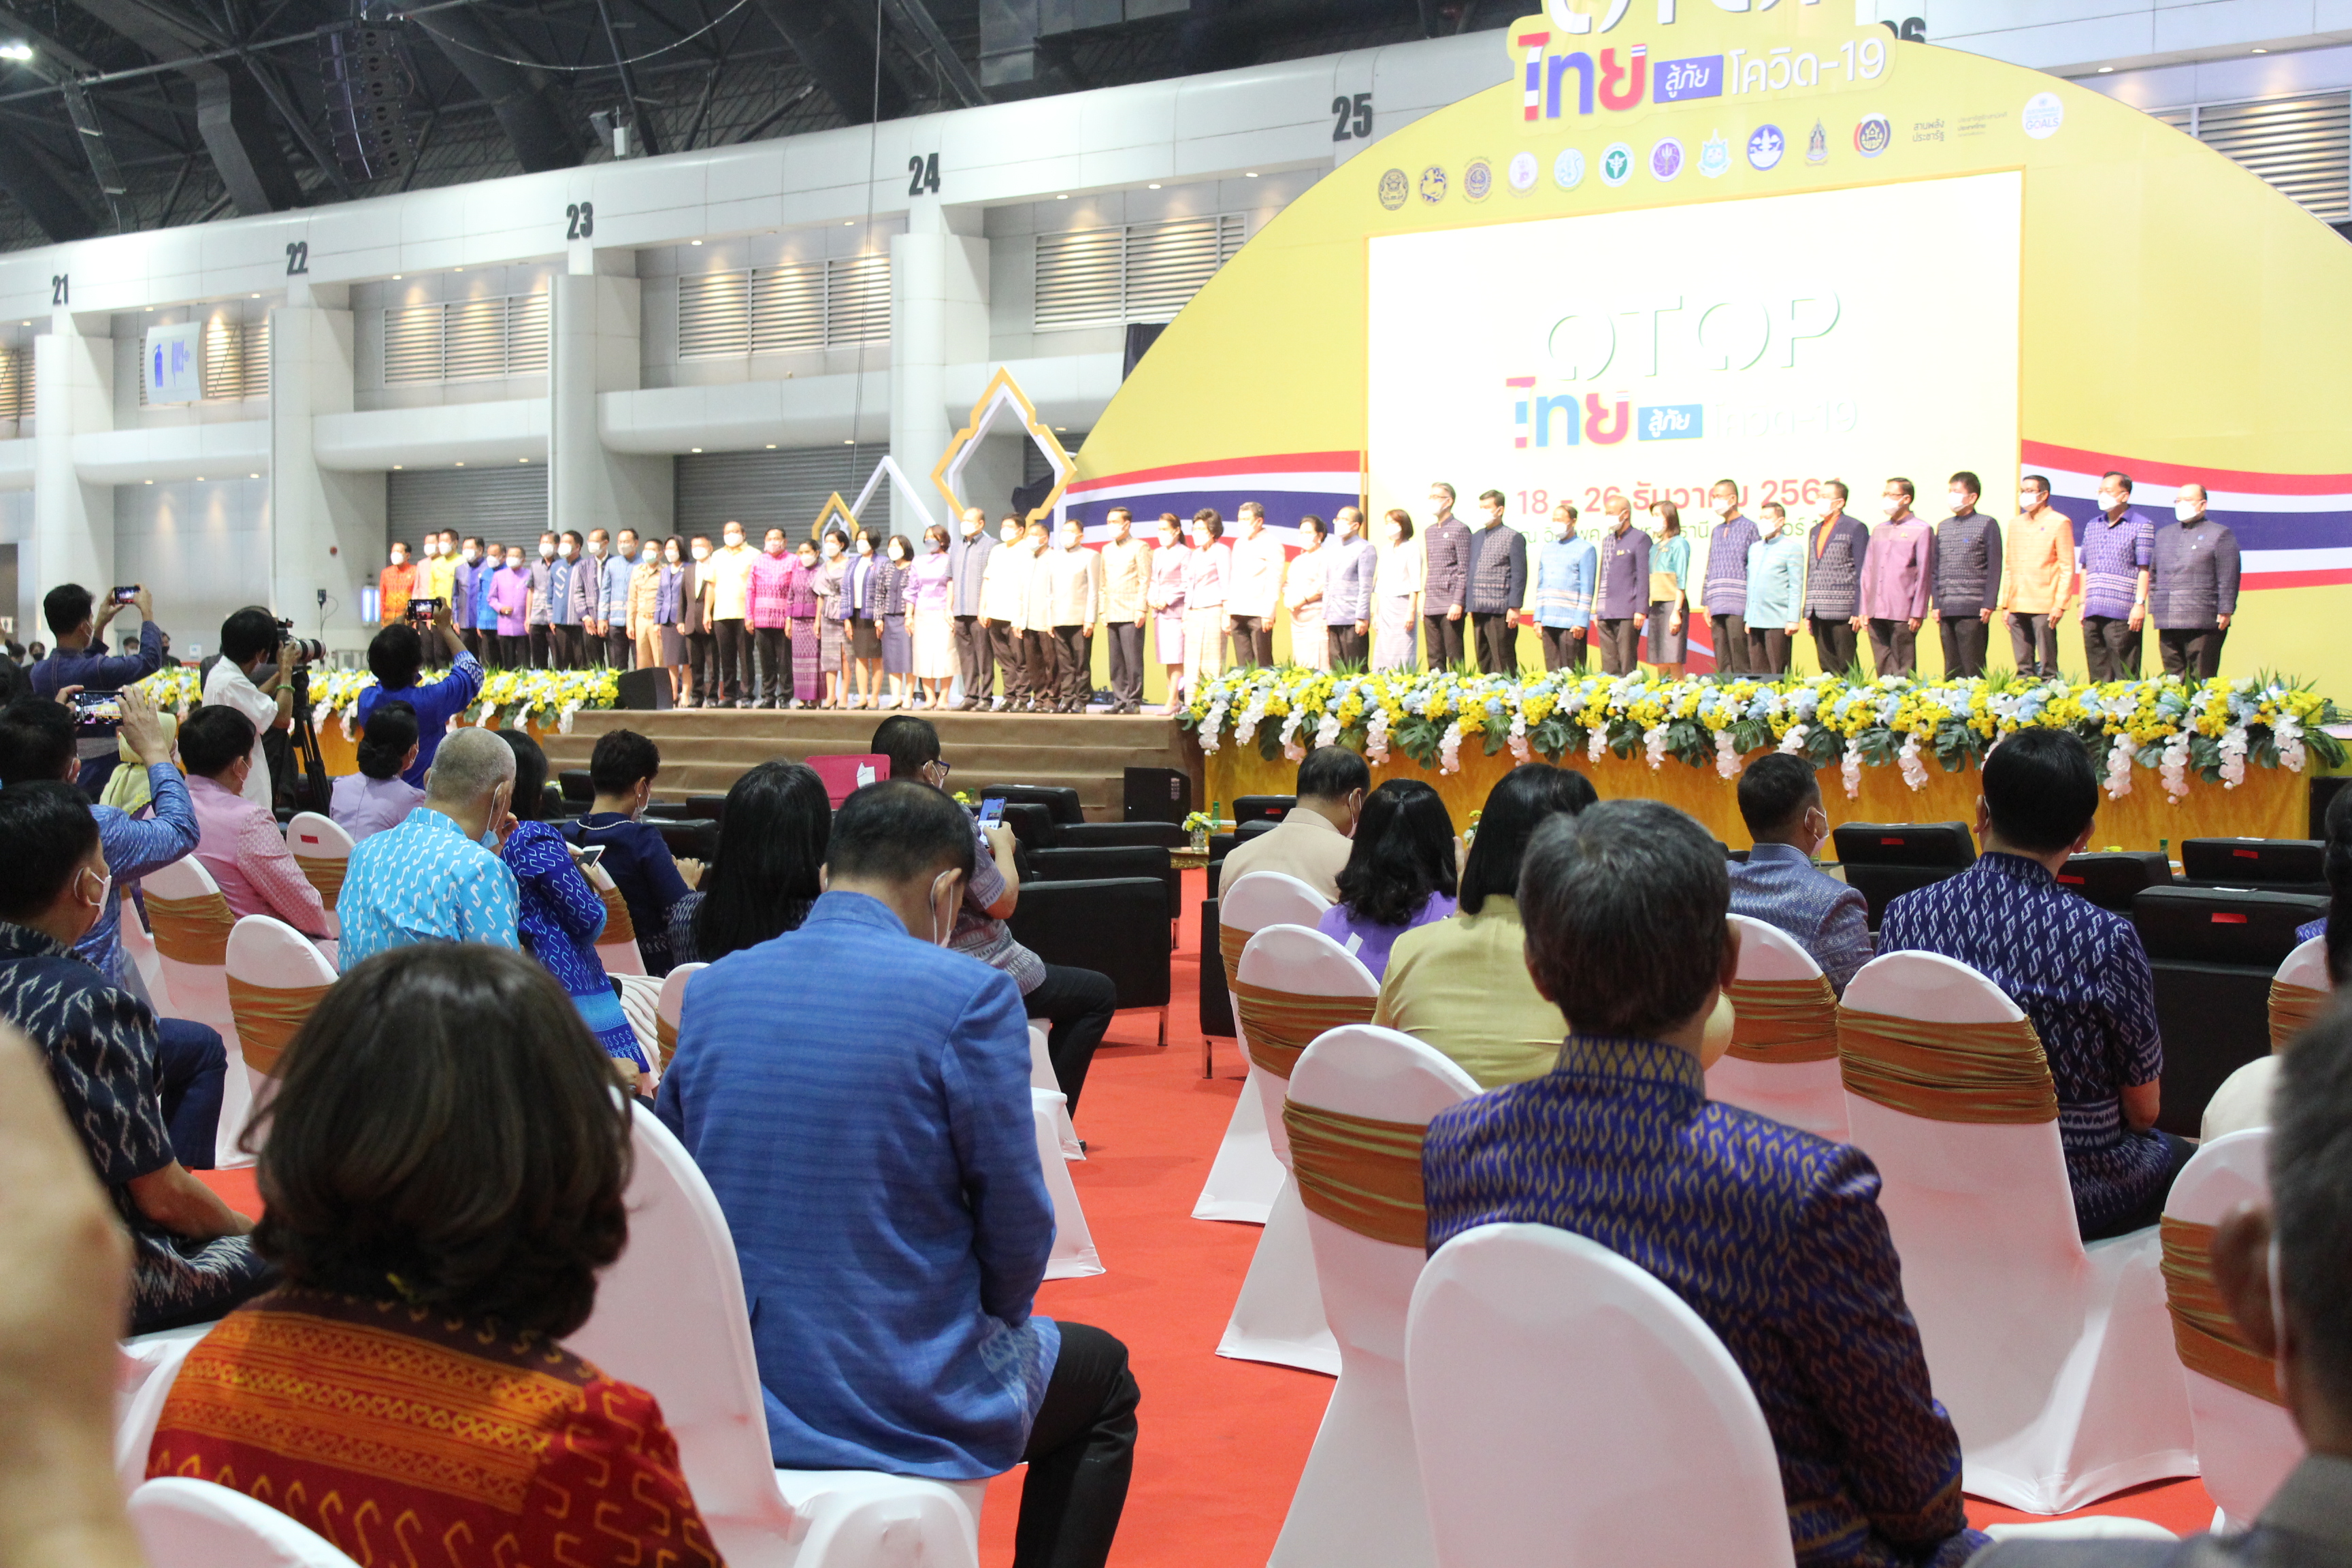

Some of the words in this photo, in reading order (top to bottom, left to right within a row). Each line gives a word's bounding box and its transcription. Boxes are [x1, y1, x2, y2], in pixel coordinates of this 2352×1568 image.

[1518, 31, 1647, 120] ไทย
[1665, 63, 1710, 98] สู้ภัย
[1729, 37, 1885, 95] โควิด-19
[1332, 93, 1373, 142] 25
[2025, 117, 2059, 130] GOALS
[909, 153, 940, 196] 24
[567, 201, 593, 240] 23
[286, 241, 308, 275] 22
[52, 274, 69, 305] 21
[1541, 283, 1841, 381] OTOP
[1506, 376, 1629, 448] ไทย
[1648, 408, 1690, 438] สู้ภัย
[1517, 489, 1548, 514] 18
